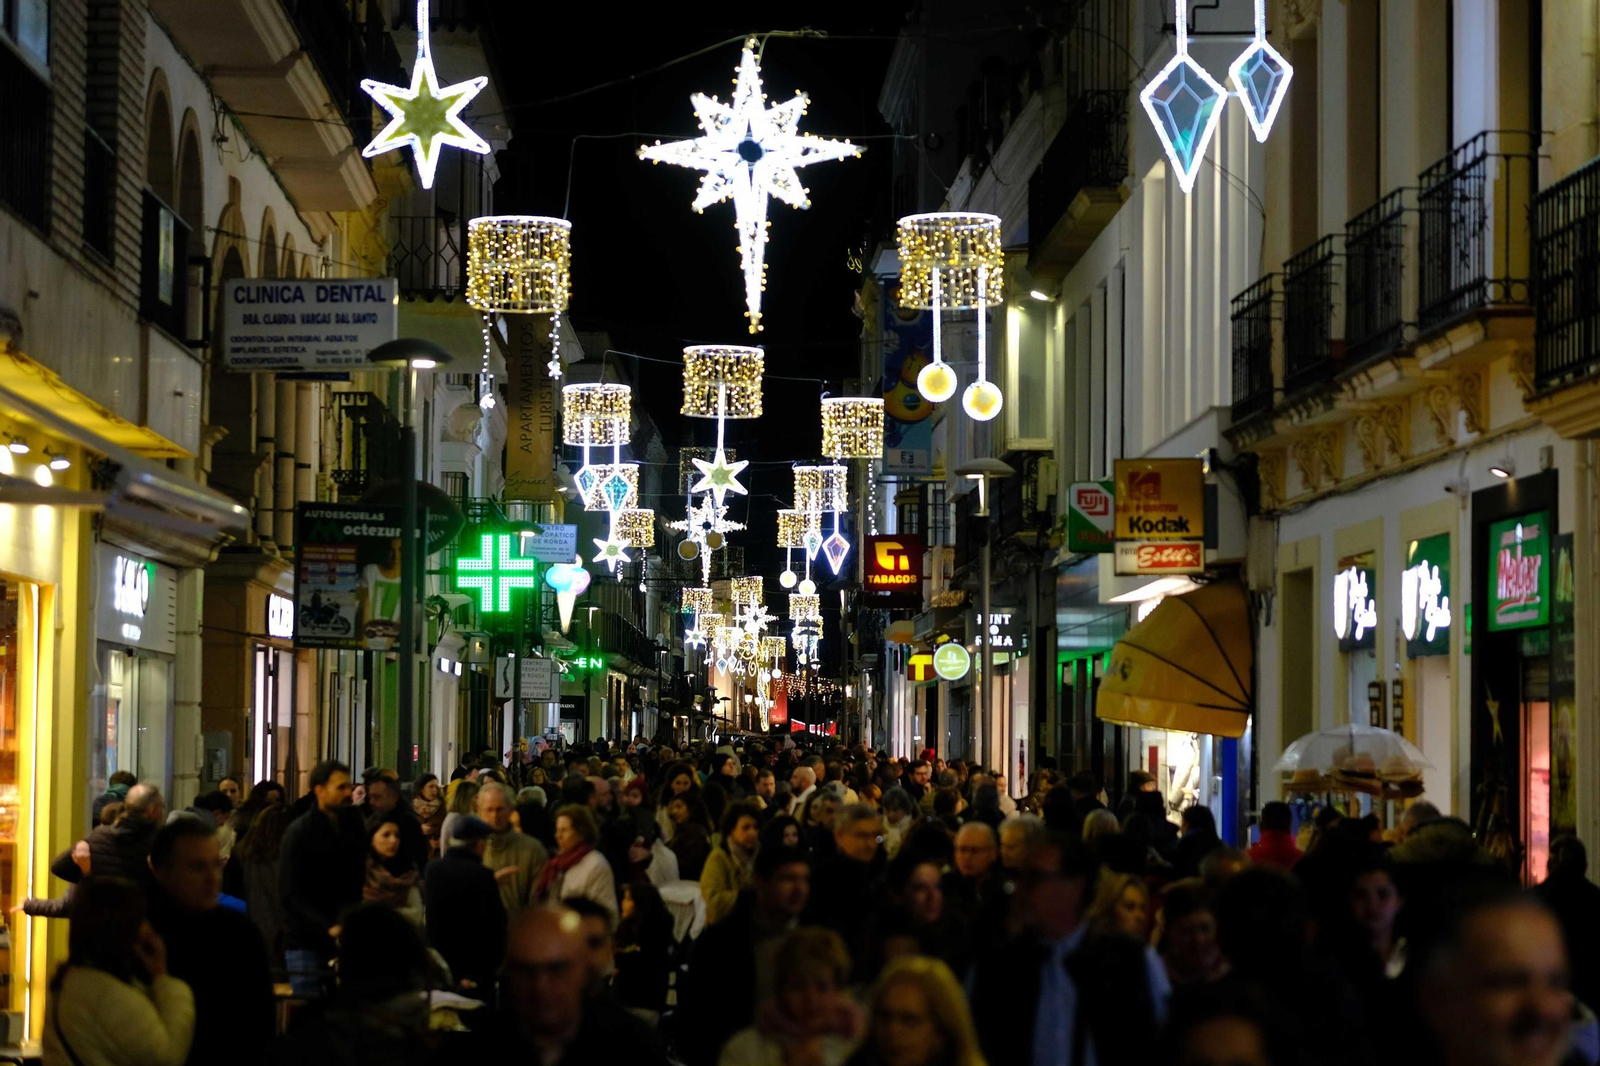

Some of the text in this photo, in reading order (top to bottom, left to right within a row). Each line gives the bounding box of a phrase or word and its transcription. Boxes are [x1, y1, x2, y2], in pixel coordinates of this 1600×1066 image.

[234, 284, 386, 304] CLINICA DENTAL
[301, 313, 331, 325] VARGAS
[520, 322, 534, 454] APARTAMENTOS
[304, 510, 385, 521] AUTOESCUELAS
[1129, 516, 1190, 533] Kodak
[867, 574, 917, 584] TABACOS
[975, 635, 1014, 647] RMA
